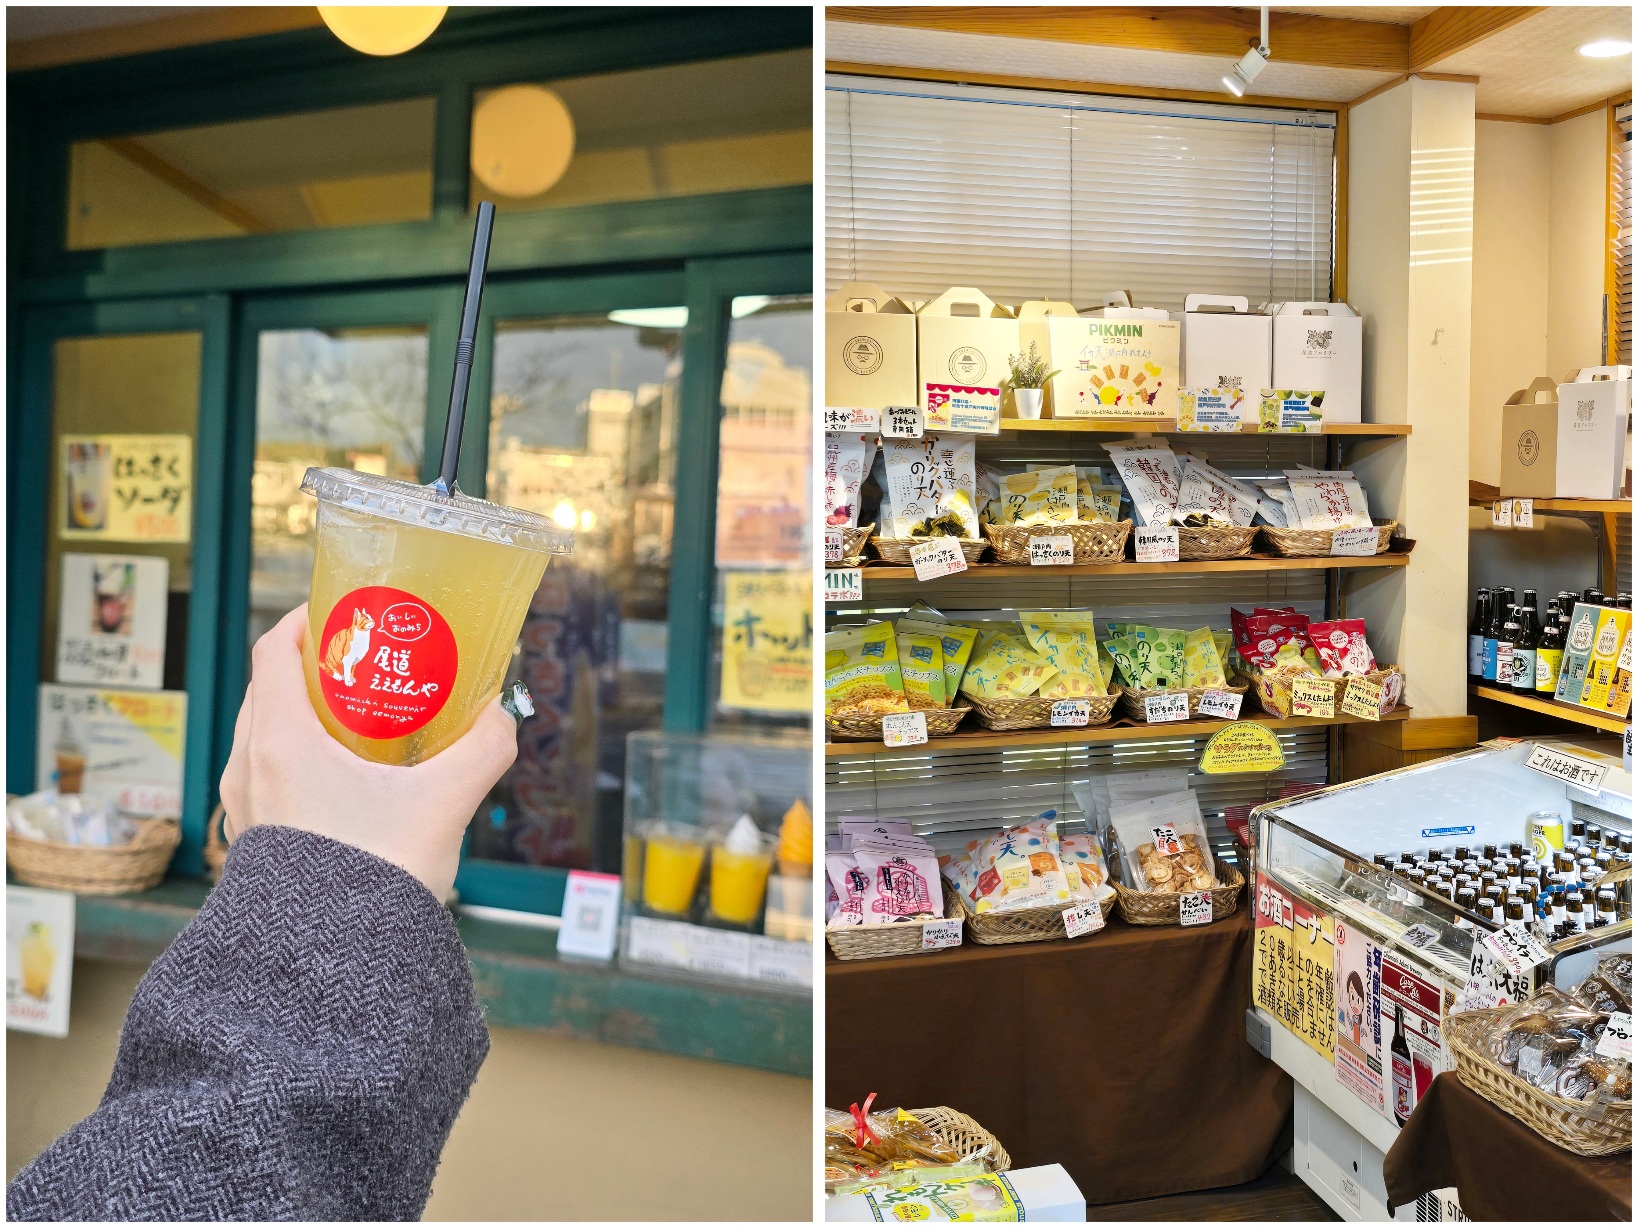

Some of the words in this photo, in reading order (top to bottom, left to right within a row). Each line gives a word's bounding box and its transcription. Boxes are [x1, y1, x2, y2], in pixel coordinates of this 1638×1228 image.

[1089, 323, 1143, 338] PIKMIN
[825, 408, 874, 424] 味が濃い
[910, 461, 929, 500] のり天
[114, 484, 187, 515] ソーダ
[1031, 550, 1072, 559] はっさくのり天
[373, 645, 412, 677] 尾道
[1137, 640, 1153, 675] のり天
[369, 673, 439, 698] ええもんや
[1148, 704, 1186, 716] すだちのり天
[1532, 752, 1600, 785] これはお酒です
[1258, 883, 1335, 946] お酒コーナー
[1502, 928, 1535, 964] ブロイラー
[1607, 1026, 1632, 1040] ブロ
